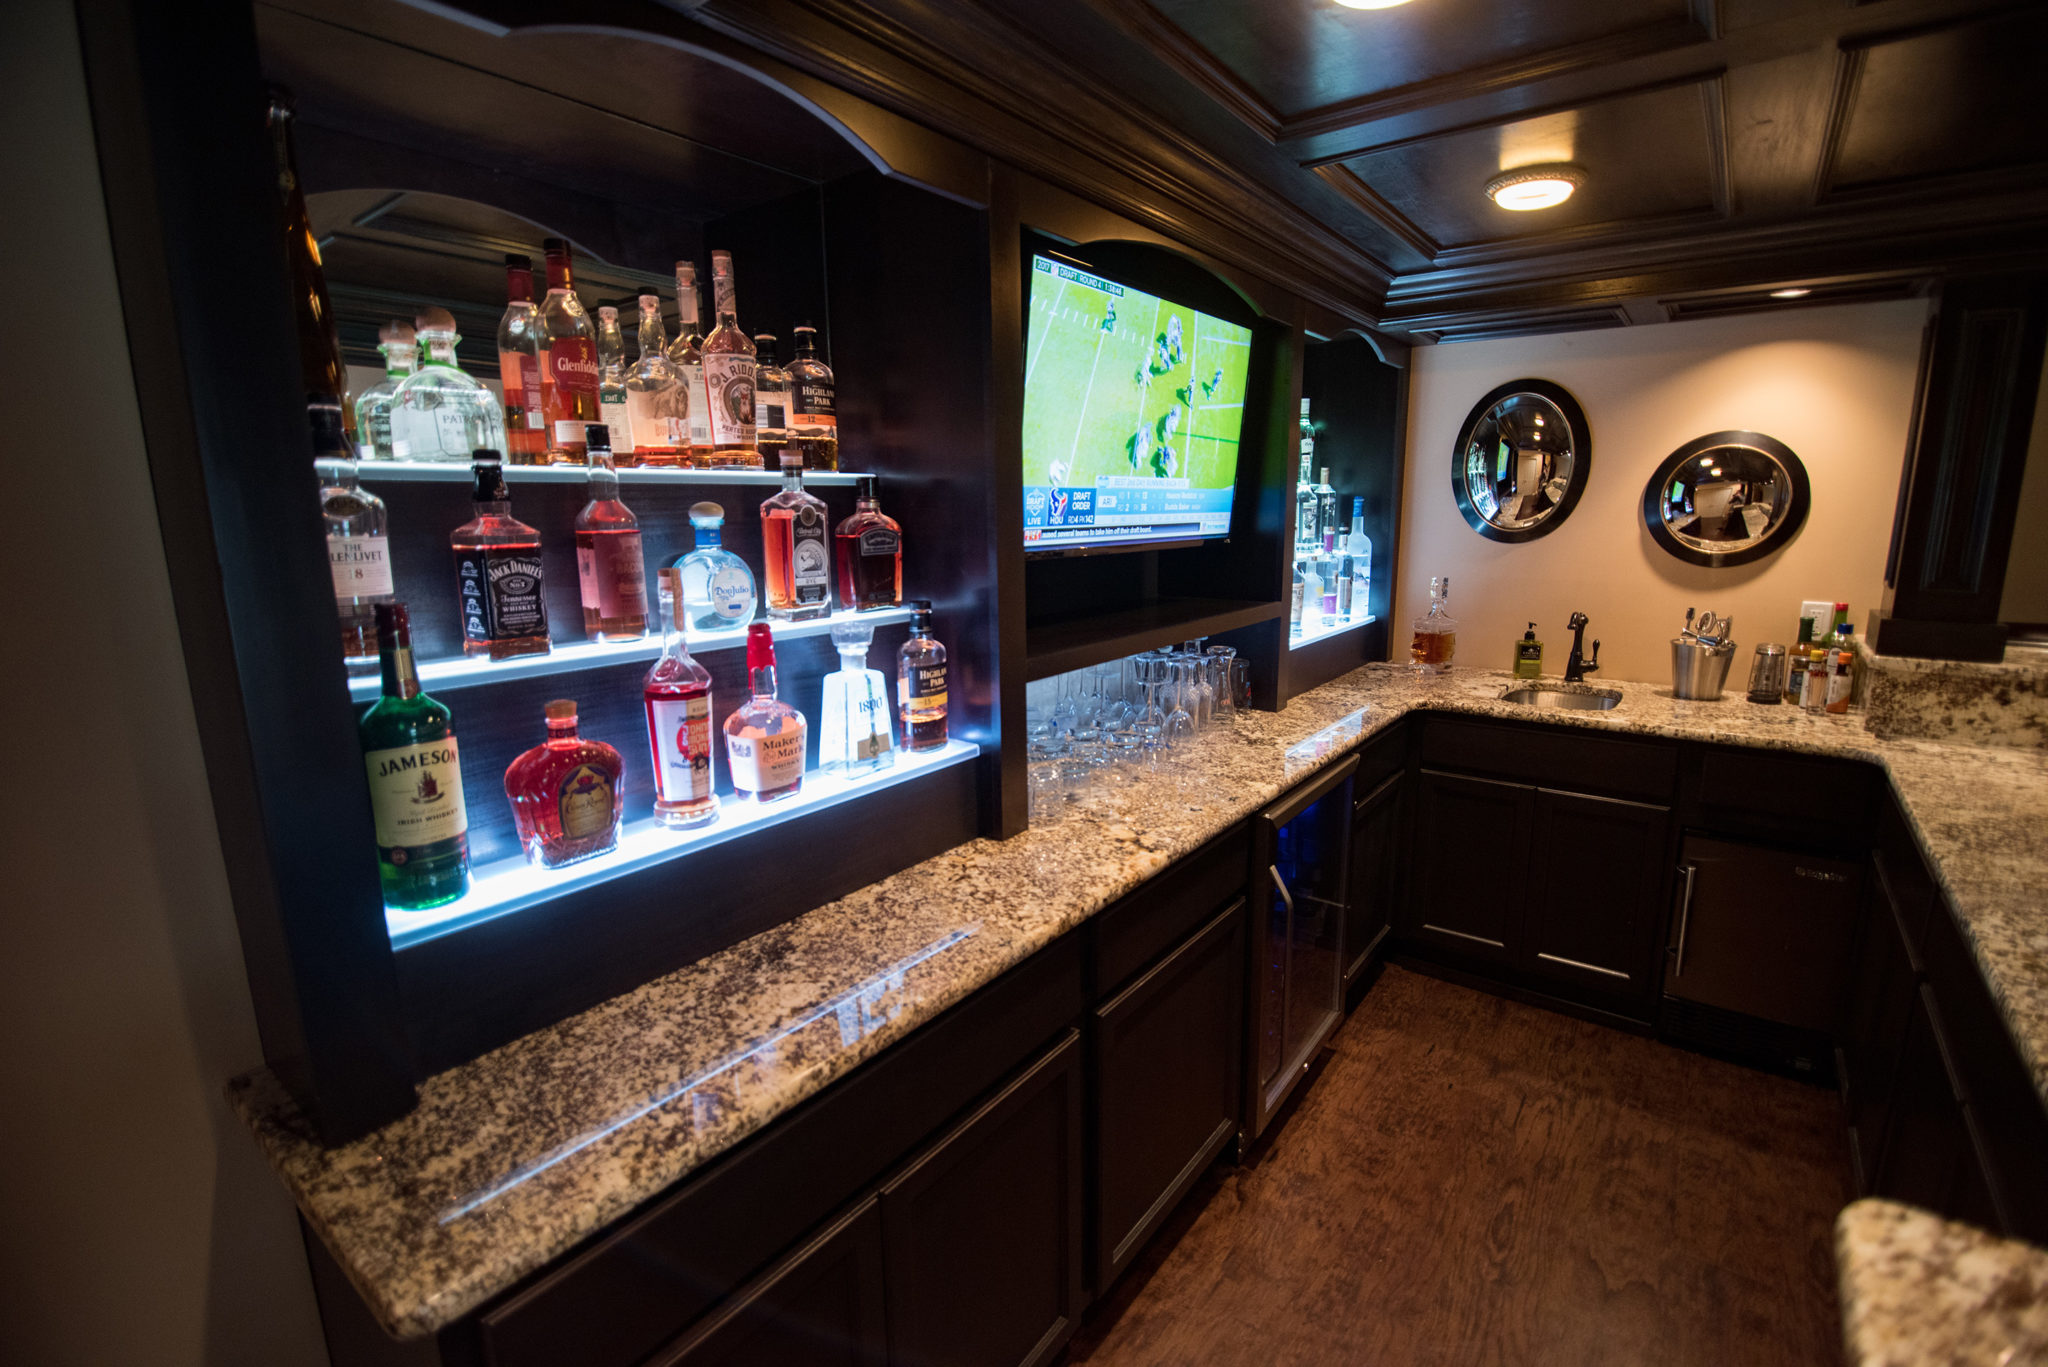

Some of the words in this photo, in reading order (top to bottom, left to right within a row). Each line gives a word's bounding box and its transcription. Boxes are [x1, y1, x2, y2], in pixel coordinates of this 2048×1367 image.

[1038, 259, 1050, 271] 2017
[1060, 266, 1078, 280] DRAFT
[1080, 274, 1098, 287] ROUND
[558, 357, 598, 375] Glenfidd
[814, 397, 830, 406] PARK
[1073, 492, 1091, 500] DRAFT
[1072, 502, 1090, 510] ORDER
[1050, 516, 1064, 524] HOU
[488, 563, 511, 582] JACK
[510, 560, 542, 580] DANIEL'S
[859, 696, 882, 712] 1800
[379, 749, 456, 777] JAMESON
[425, 808, 458, 821] WHISKEY
